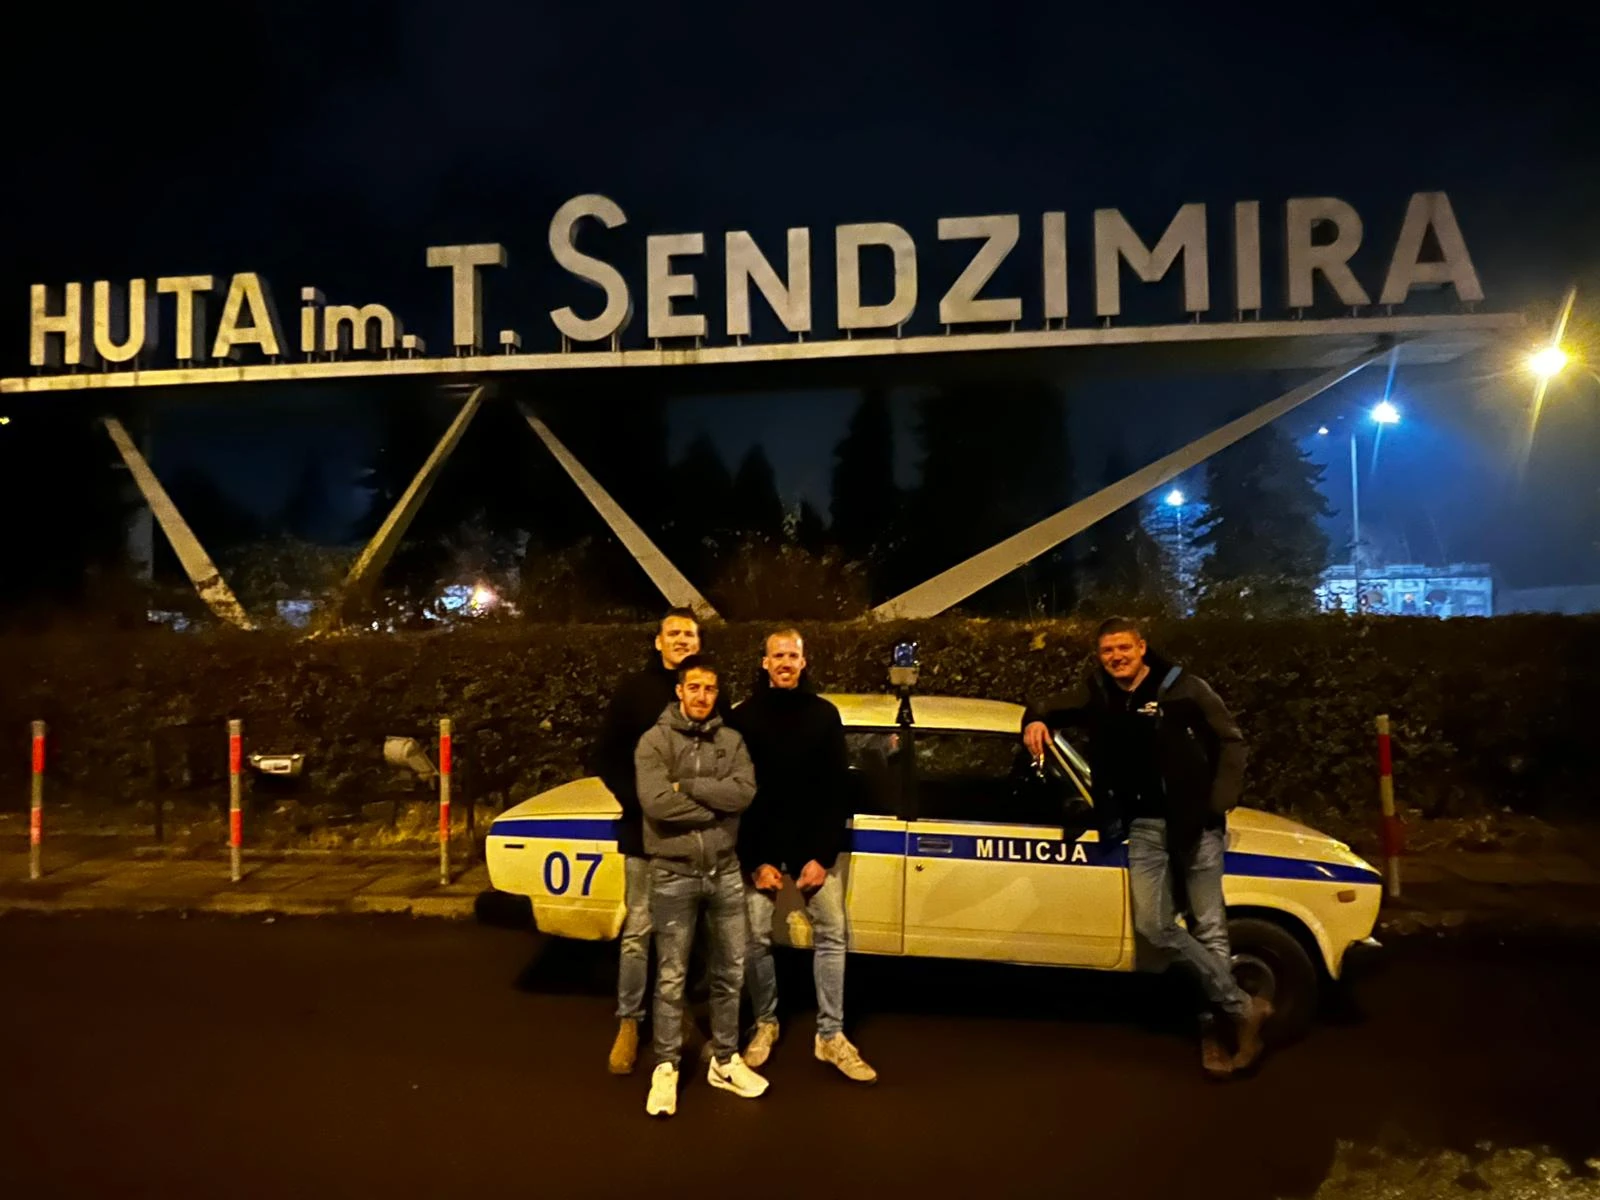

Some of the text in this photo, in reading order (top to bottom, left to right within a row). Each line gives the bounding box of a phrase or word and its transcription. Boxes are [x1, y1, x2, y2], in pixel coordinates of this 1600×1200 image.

[30, 191, 1485, 366] HUTA im. T. SENDZIMIRA
[976, 838, 1088, 863] MILICJA
[544, 851, 603, 896] 07
